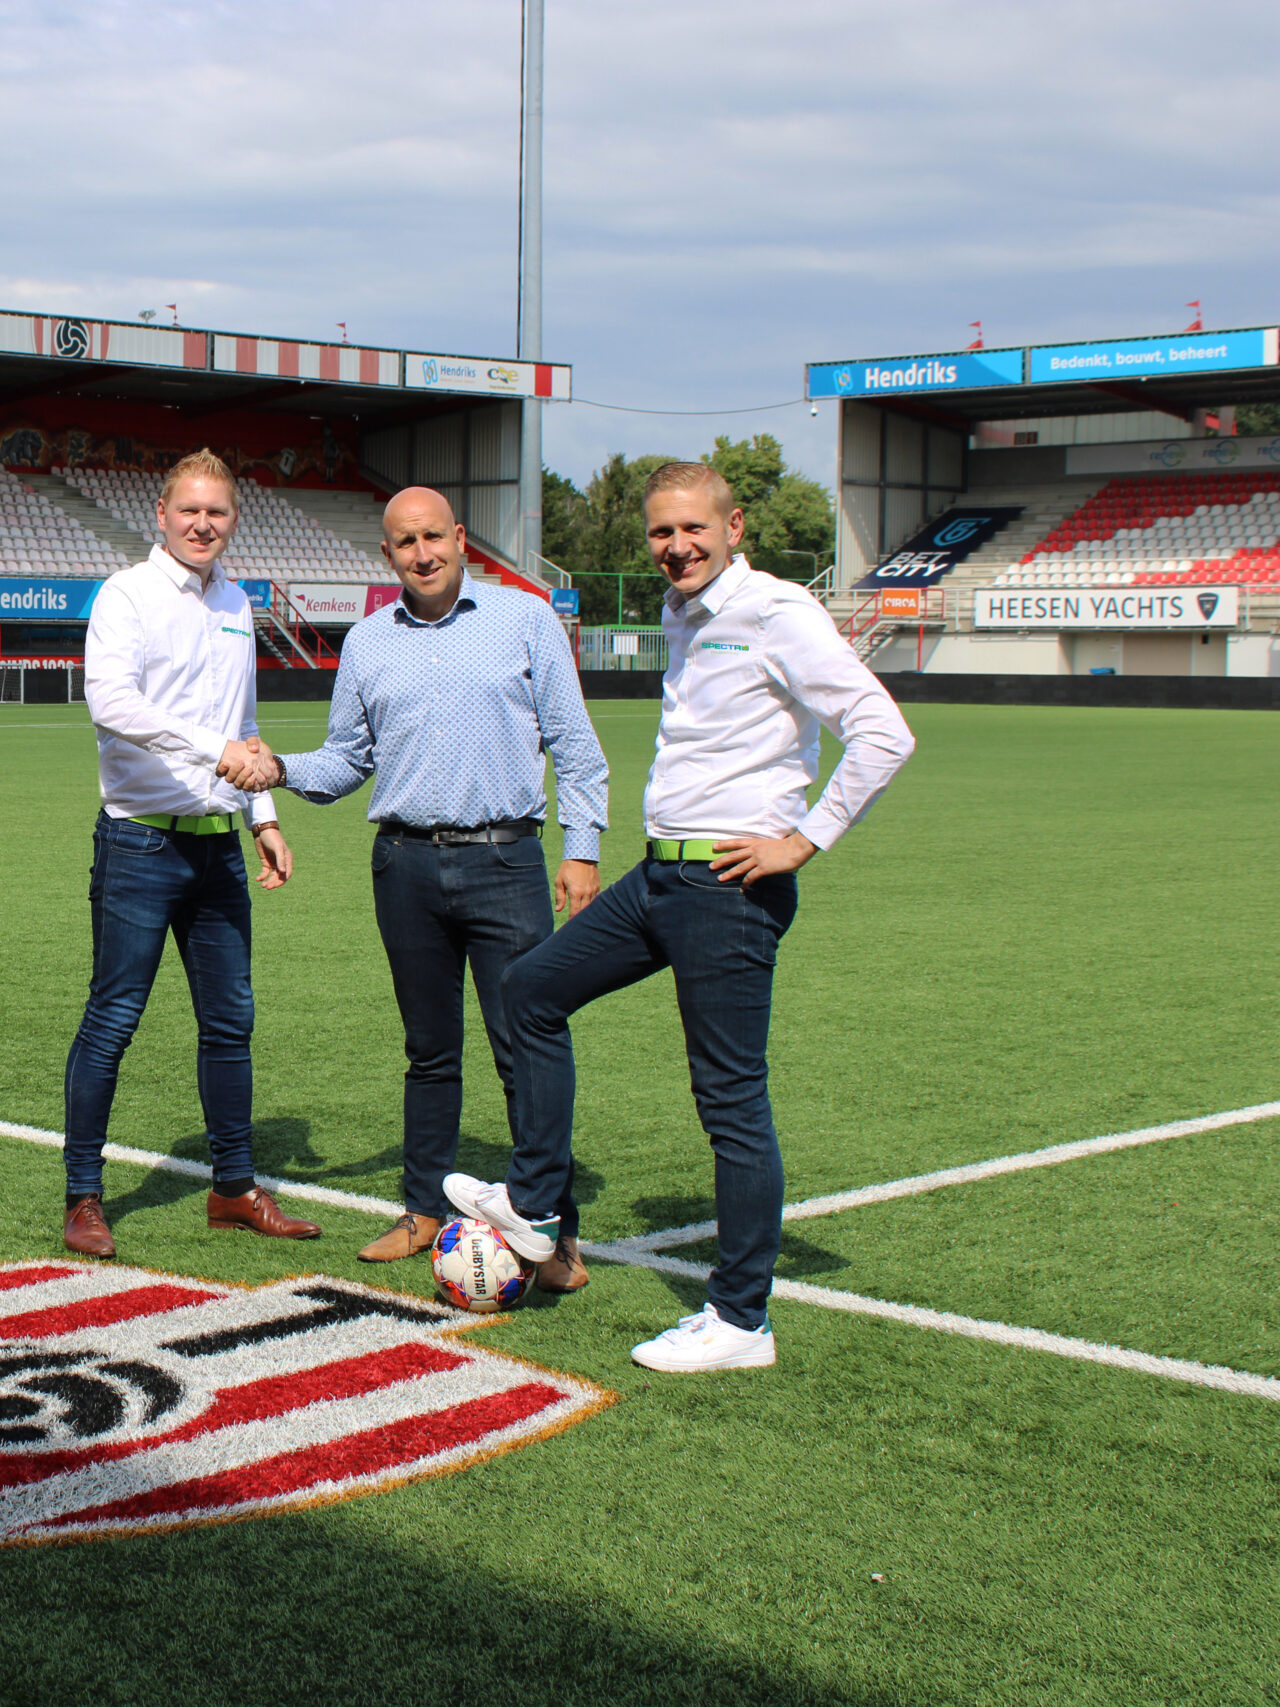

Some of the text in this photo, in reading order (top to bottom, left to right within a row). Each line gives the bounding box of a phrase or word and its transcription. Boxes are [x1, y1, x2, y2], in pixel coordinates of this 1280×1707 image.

[1050, 344, 1228, 370] Bedenkt, bouwt, beheert
[440, 365, 477, 378] Hendriks
[864, 361, 958, 389] Hendriks
[888, 551, 952, 564] BET
[876, 563, 949, 577] CITY
[306, 598, 357, 613] Kemkens
[884, 597, 917, 608] CIRCA
[989, 595, 1184, 618] HEESEN YACHTS
[471, 1238, 488, 1295] DERBYSTAR
